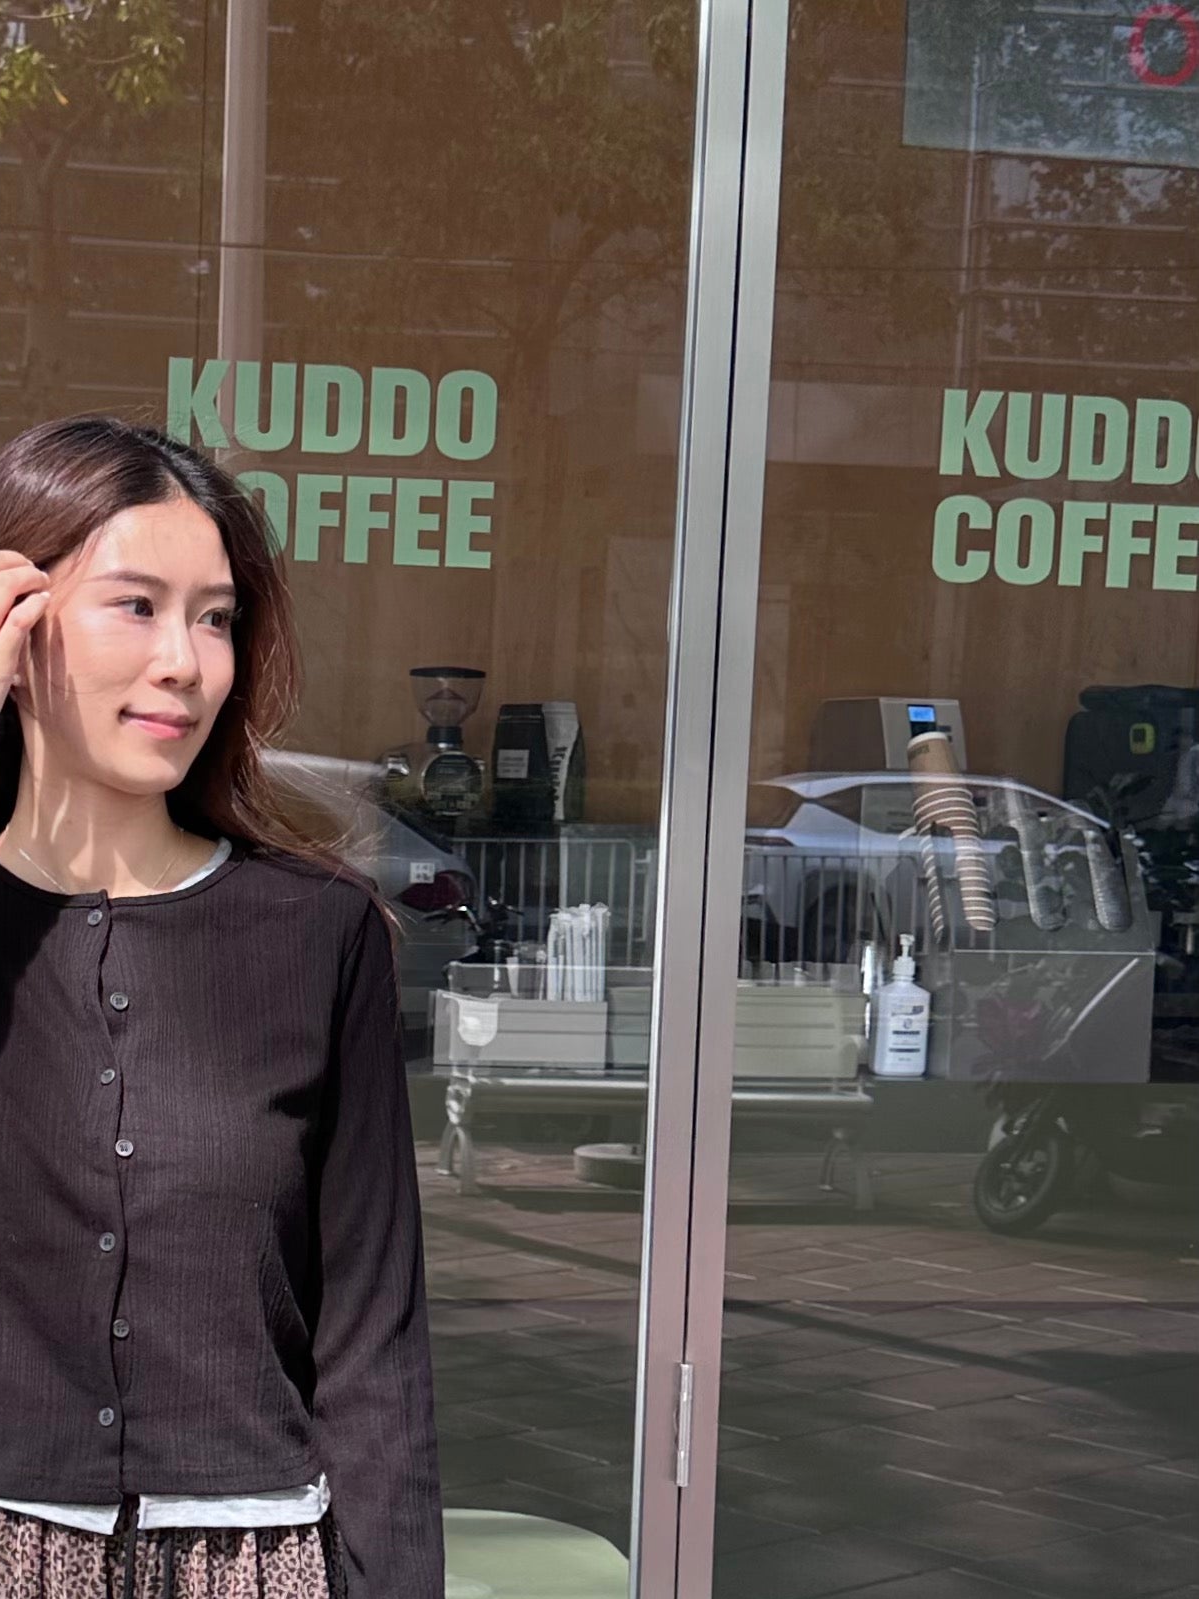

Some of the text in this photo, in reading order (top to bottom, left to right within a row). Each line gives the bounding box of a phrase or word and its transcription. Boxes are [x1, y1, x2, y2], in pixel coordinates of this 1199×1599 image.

[167, 356, 498, 460] KUDDO
[939, 388, 1199, 485] KUDD
[236, 471, 495, 568] OFFEE
